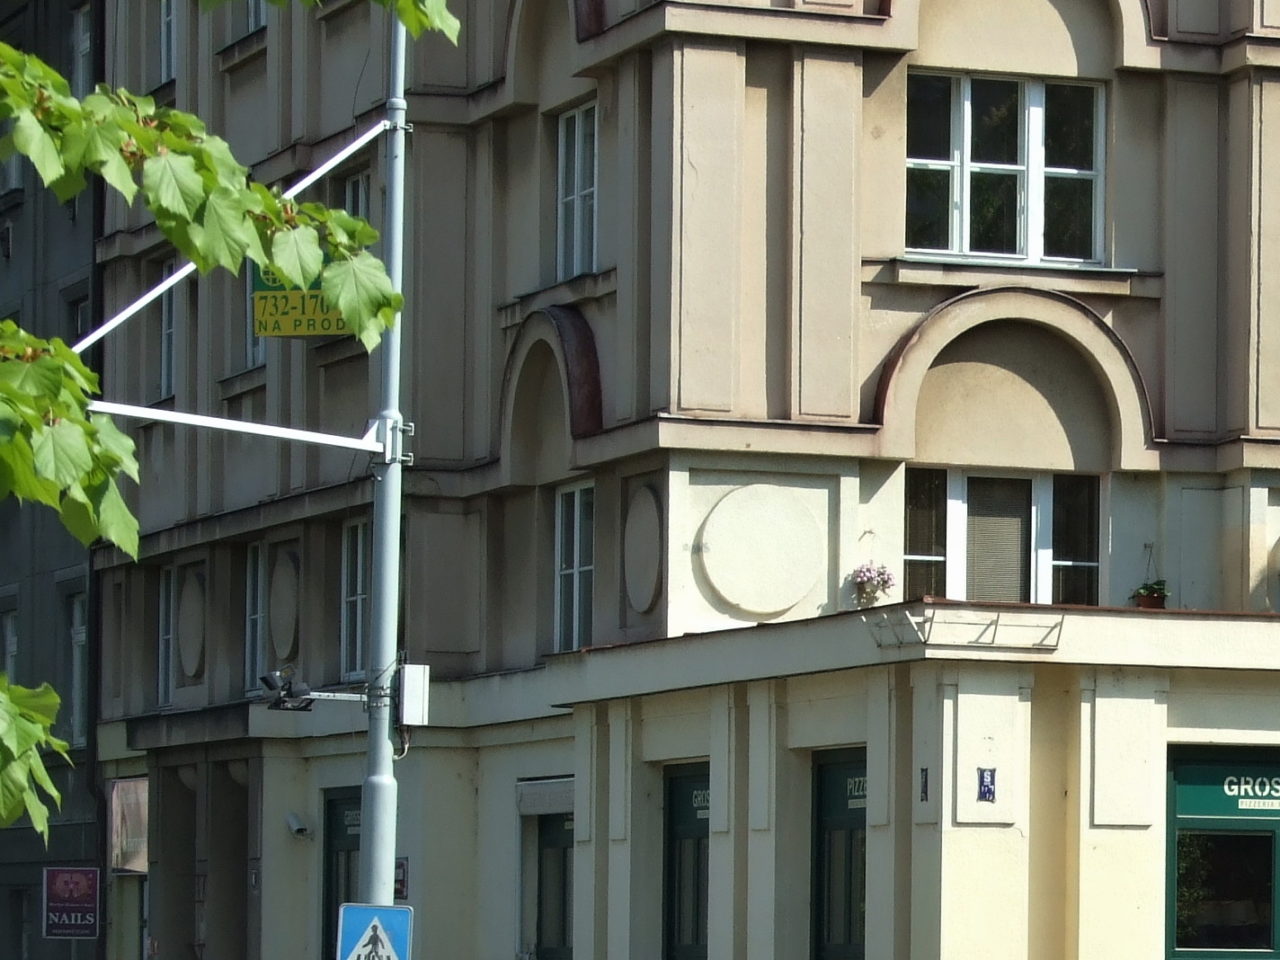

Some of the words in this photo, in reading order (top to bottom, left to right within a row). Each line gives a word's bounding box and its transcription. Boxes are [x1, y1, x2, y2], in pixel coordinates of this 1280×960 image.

[258, 320, 282, 332] NA
[294, 318, 346, 331] PROD
[48, 912, 95, 925] NAILS
